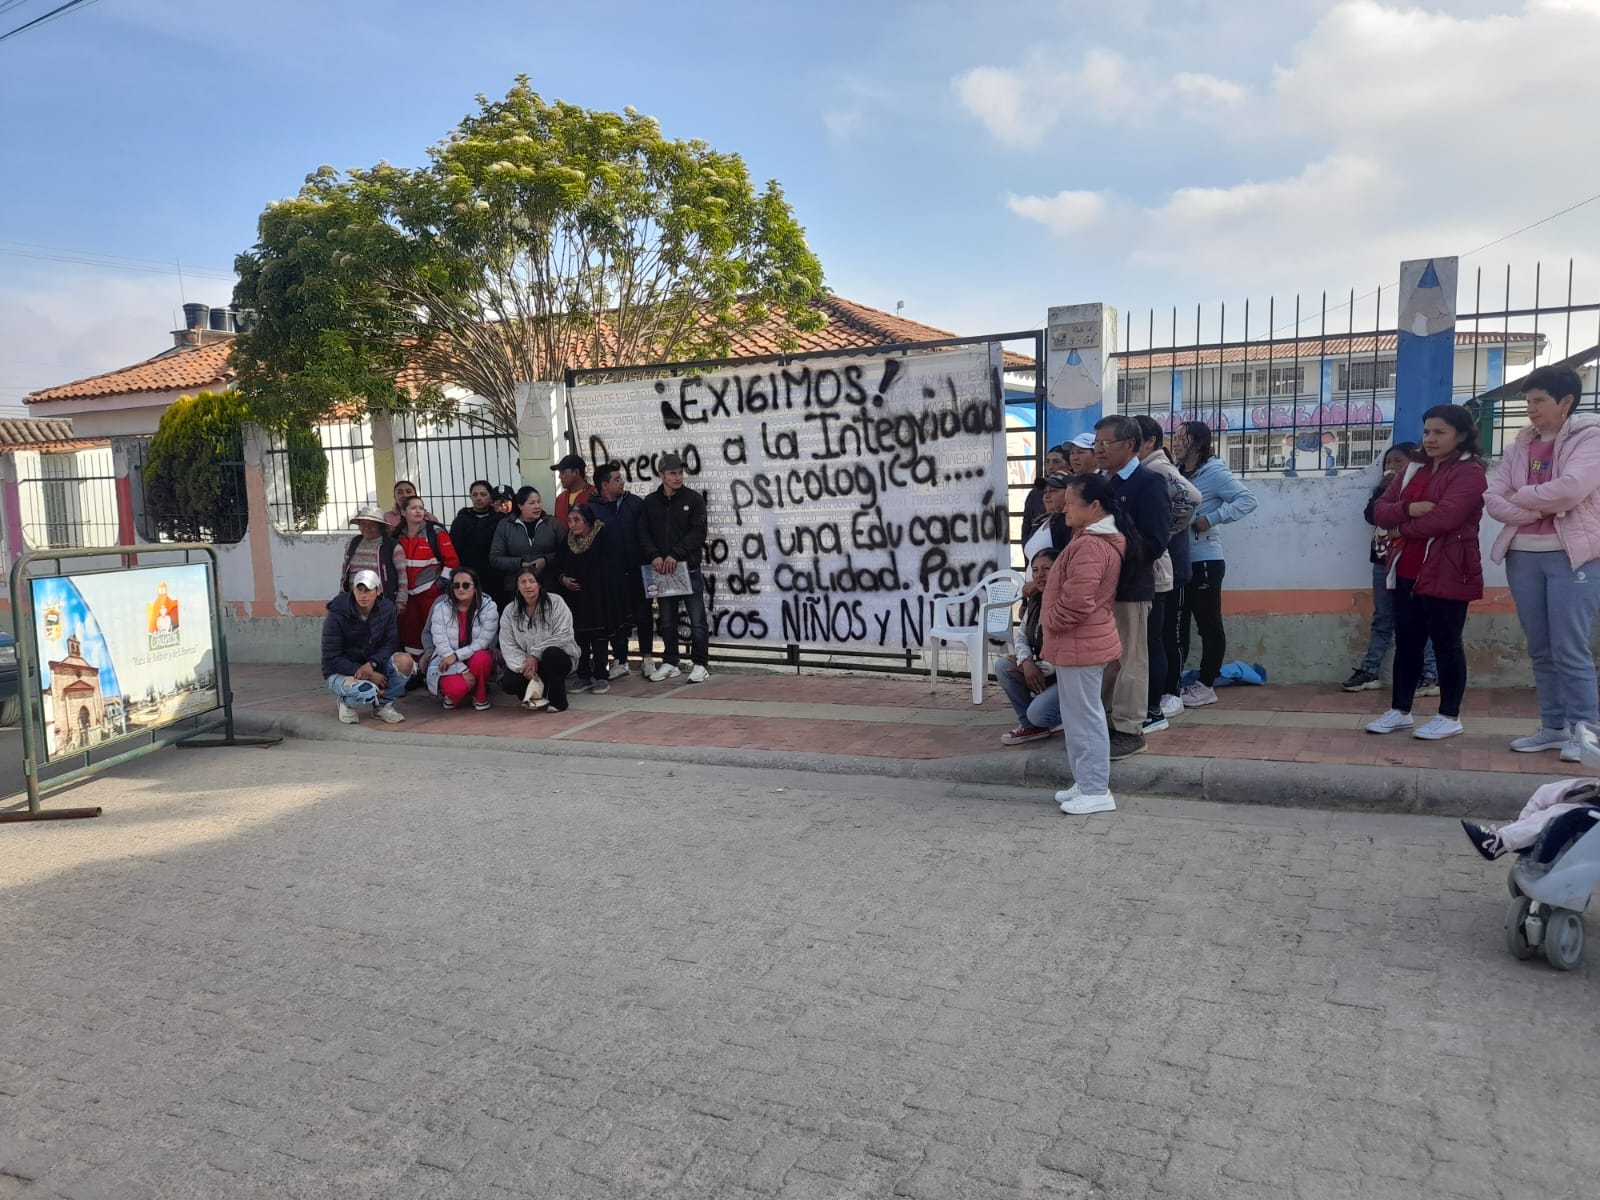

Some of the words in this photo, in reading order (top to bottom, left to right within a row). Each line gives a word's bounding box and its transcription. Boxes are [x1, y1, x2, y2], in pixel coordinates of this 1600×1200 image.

[722, 434, 748, 466] a
[761, 421, 800, 461] la
[804, 366, 1002, 469] Integridad
[742, 532, 768, 561] a
[774, 522, 843, 556] una
[852, 489, 1010, 550] Educación
[727, 557, 761, 595] de
[781, 593, 867, 643] NIÑOS
